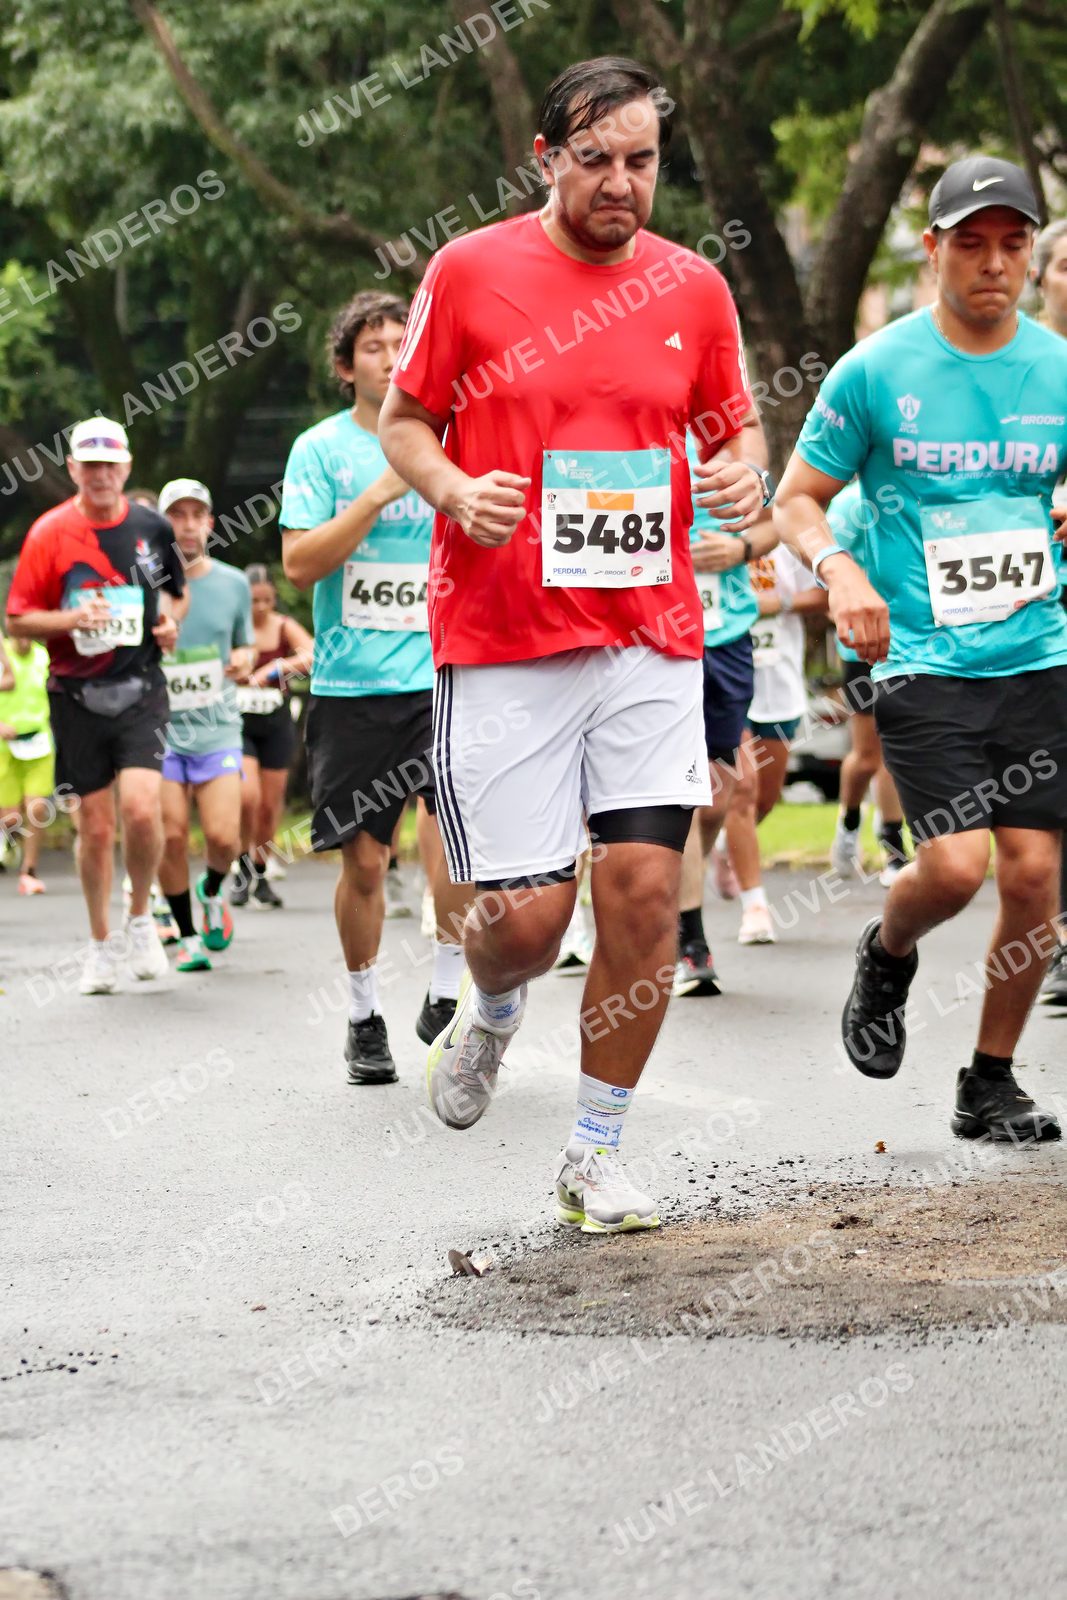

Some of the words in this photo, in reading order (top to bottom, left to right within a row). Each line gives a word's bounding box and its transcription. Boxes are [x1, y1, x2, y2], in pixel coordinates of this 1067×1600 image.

[1021, 415, 1065, 425] BROOKS
[893, 438, 1058, 473] PERDURA
[553, 512, 666, 554] 5483
[553, 568, 587, 576] PERDURA
[656, 575, 670, 583] 5483
[938, 552, 1044, 596] 3547
